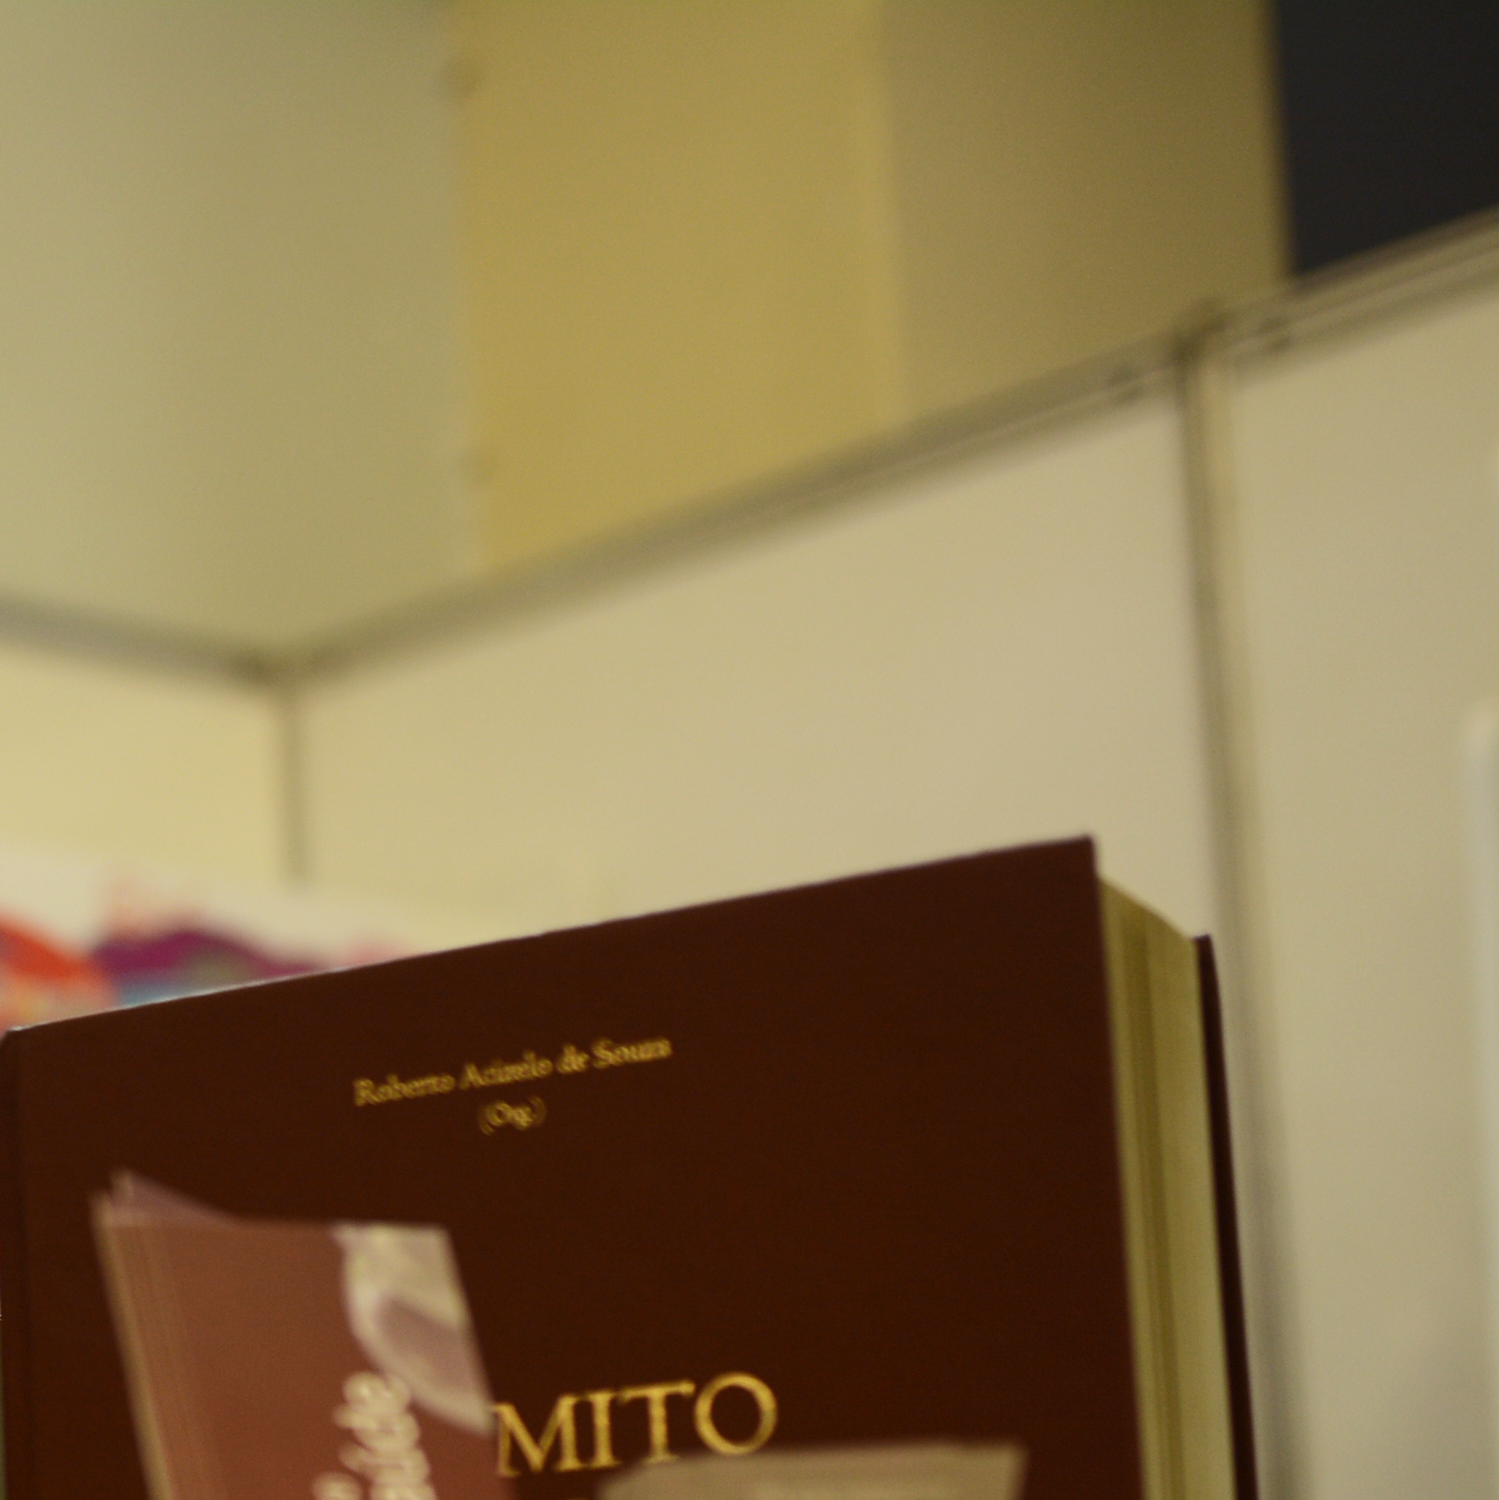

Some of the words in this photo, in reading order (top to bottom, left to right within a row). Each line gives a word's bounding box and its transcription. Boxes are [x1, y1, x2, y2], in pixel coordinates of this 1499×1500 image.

[556, 1043, 590, 1075] de
[591, 1037, 671, 1070] Souza
[490, 1372, 779, 1478] MITO
